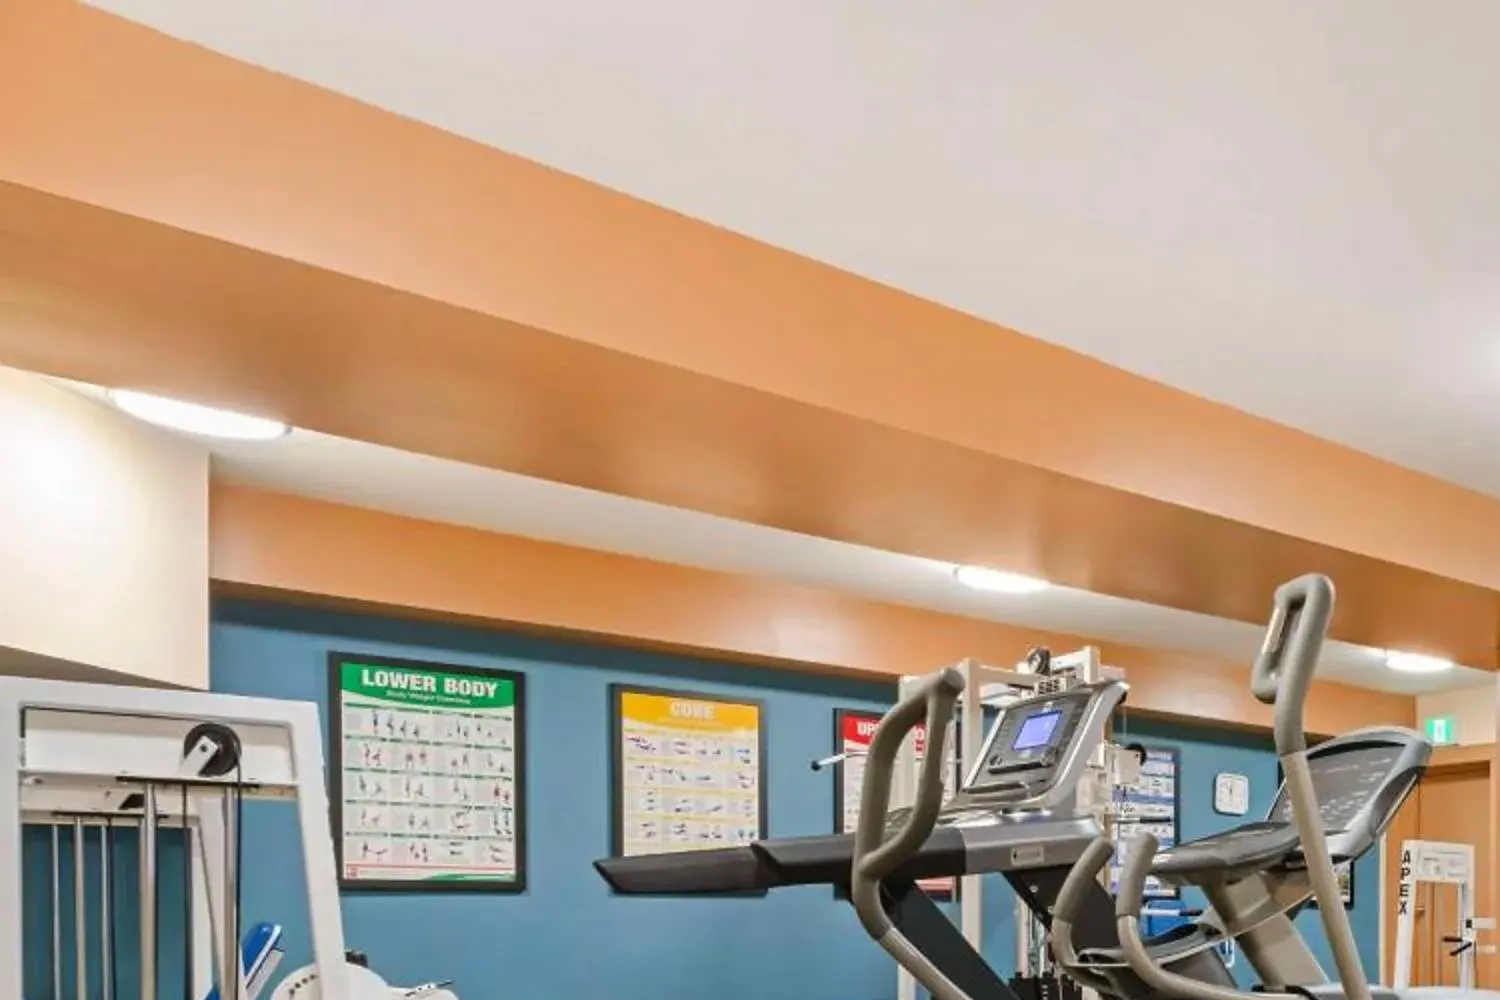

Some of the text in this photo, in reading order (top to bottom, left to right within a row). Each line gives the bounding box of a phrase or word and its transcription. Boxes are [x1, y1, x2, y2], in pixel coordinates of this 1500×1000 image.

[361, 668, 498, 698] LOWER BODY
[1399, 850, 1411, 915] APEX
